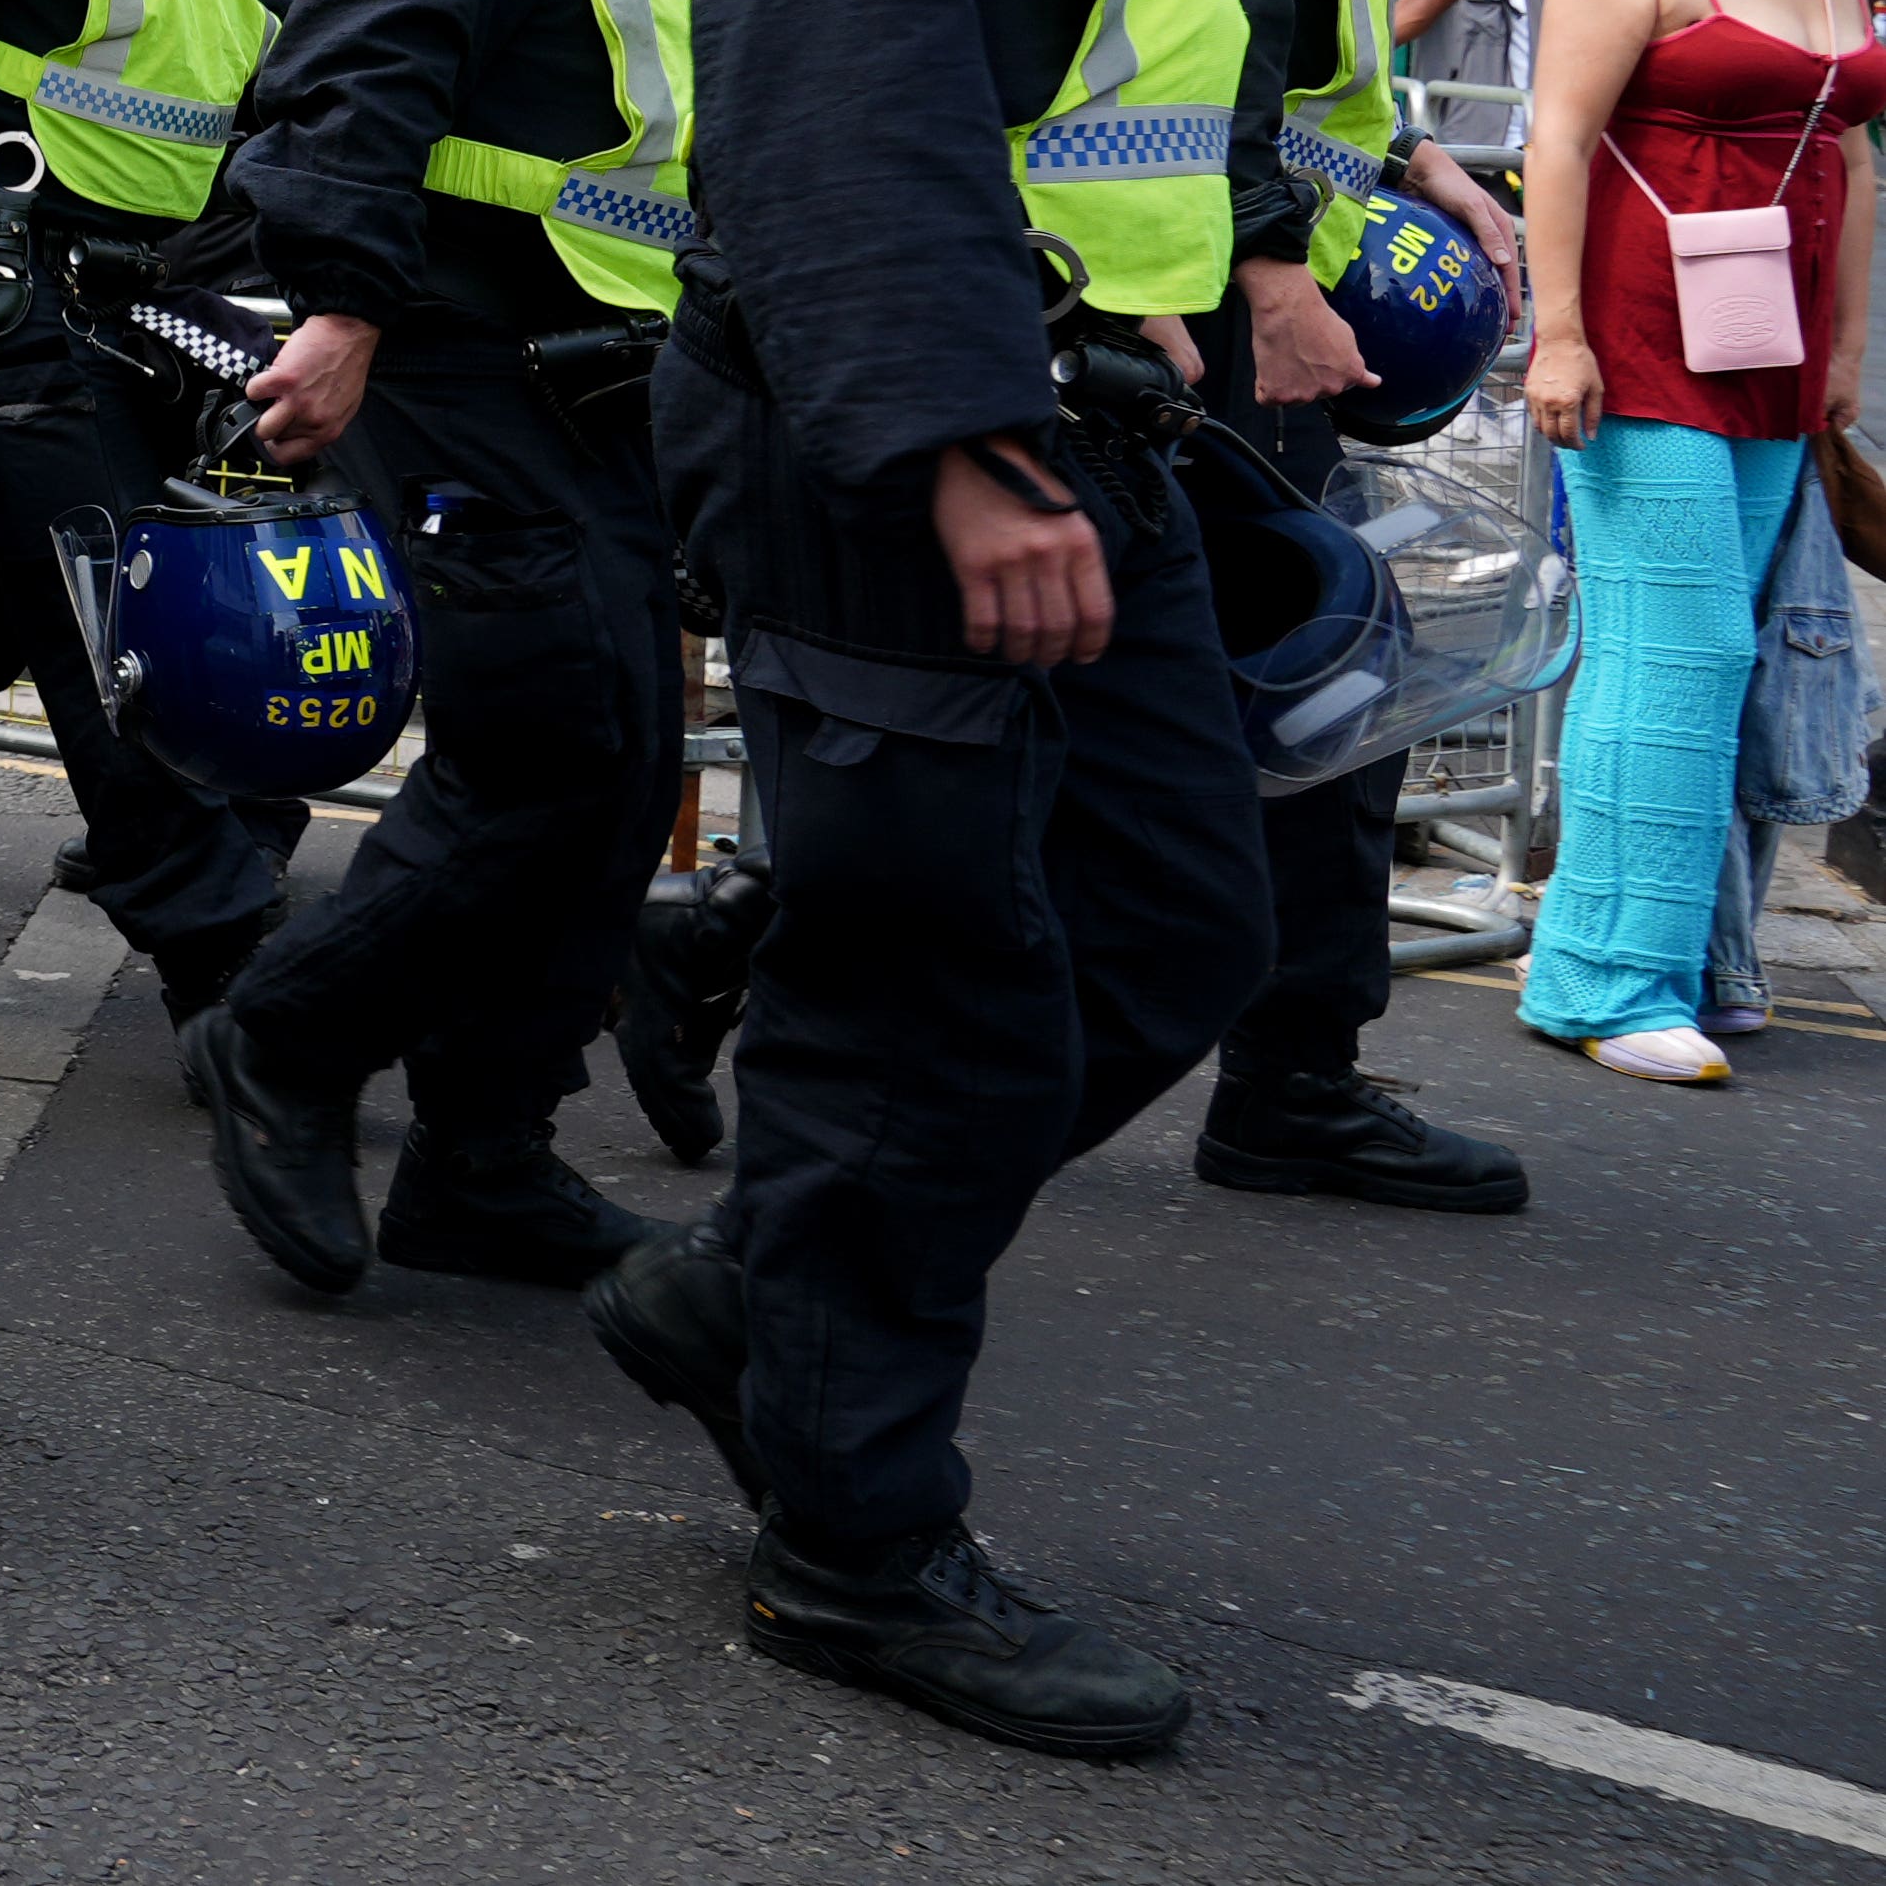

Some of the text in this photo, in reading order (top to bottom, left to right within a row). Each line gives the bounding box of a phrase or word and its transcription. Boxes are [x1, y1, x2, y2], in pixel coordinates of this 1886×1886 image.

[1387, 221, 1435, 275] MP
[1409, 238, 1470, 312] 2872
[301, 629, 371, 675] MP
[266, 695, 377, 729] 0253
